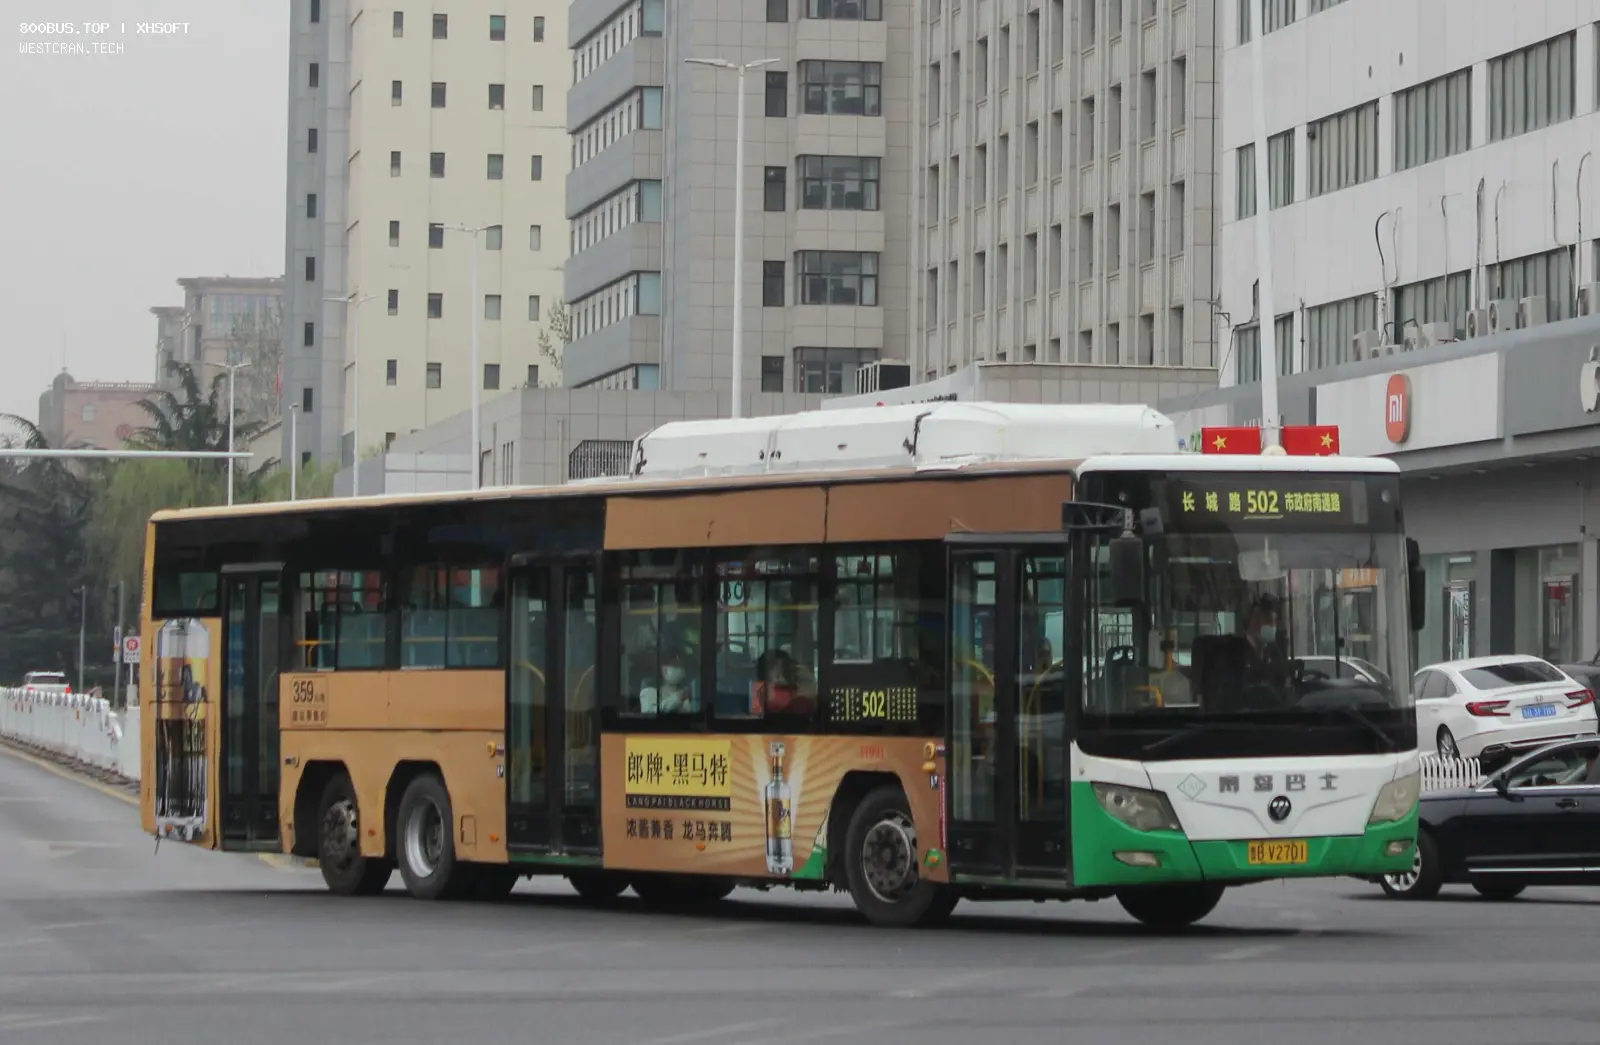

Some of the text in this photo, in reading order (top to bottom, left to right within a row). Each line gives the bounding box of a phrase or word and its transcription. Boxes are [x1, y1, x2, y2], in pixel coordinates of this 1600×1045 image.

[1182, 490, 1341, 513] 长城路 502 市政府南通路
[293, 681, 314, 703] 359
[862, 691, 885, 718] 502
[628, 752, 728, 786] 郎牌·黑马特
